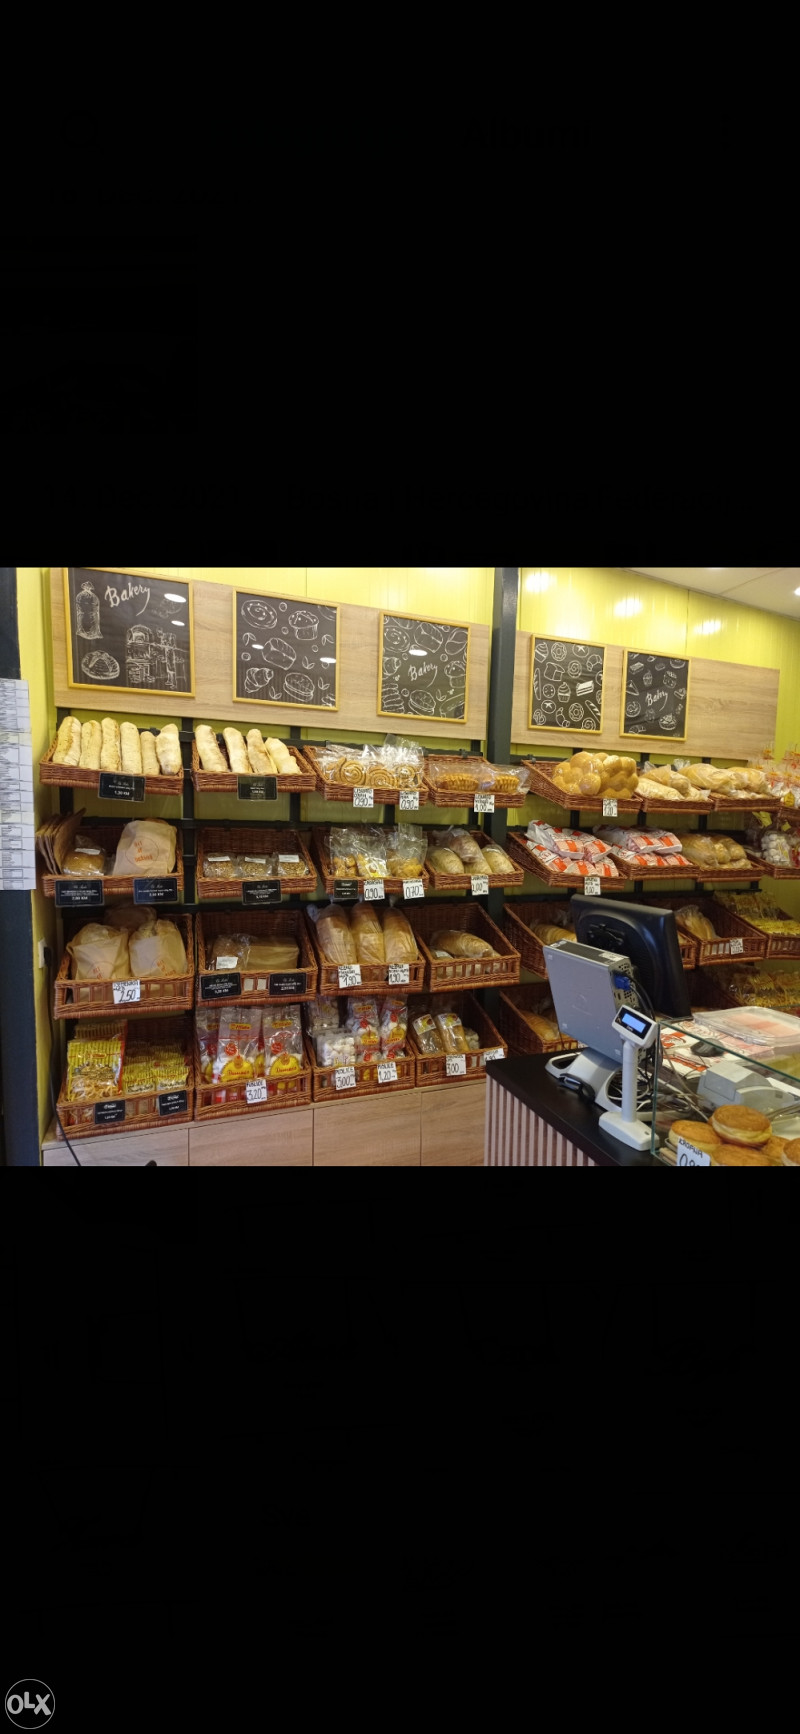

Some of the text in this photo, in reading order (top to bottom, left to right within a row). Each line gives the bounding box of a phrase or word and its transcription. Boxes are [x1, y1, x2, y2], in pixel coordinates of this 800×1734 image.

[105, 582, 150, 617] Bakery
[408, 661, 438, 689] Bakery
[645, 689, 668, 712] Bakery
